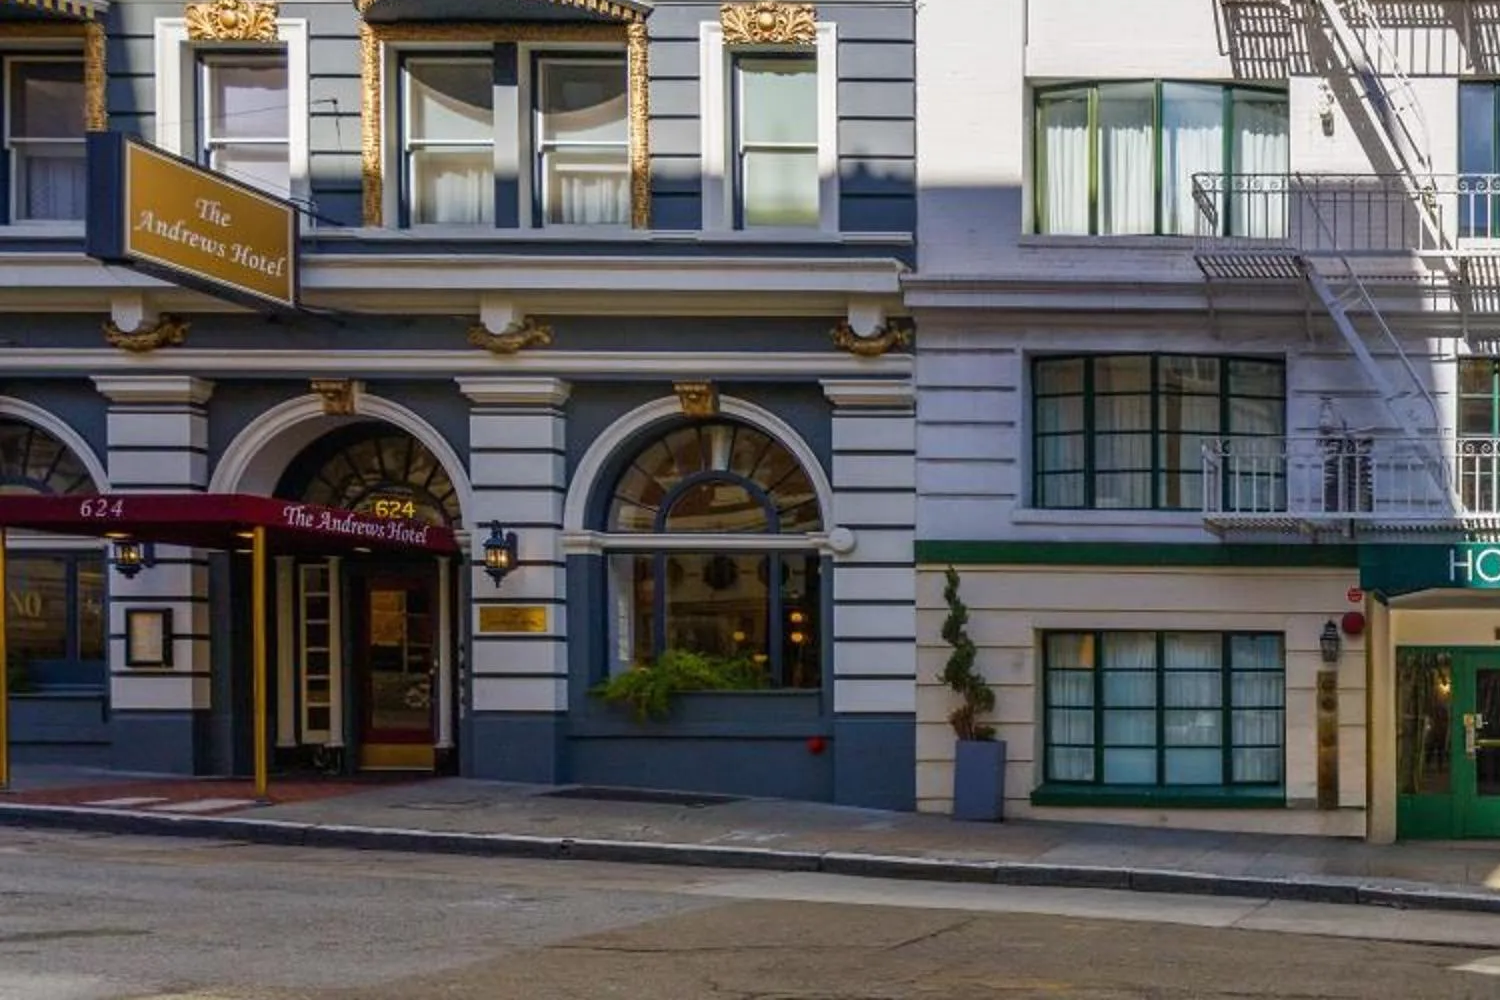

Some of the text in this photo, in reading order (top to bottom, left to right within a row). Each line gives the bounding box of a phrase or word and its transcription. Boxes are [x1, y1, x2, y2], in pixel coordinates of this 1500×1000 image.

[195, 198, 232, 228] The
[133, 210, 286, 277] Andrews Hotel
[80, 499, 123, 517] 624
[375, 500, 416, 518] 624
[283, 505, 431, 543] The Andrews Hotel
